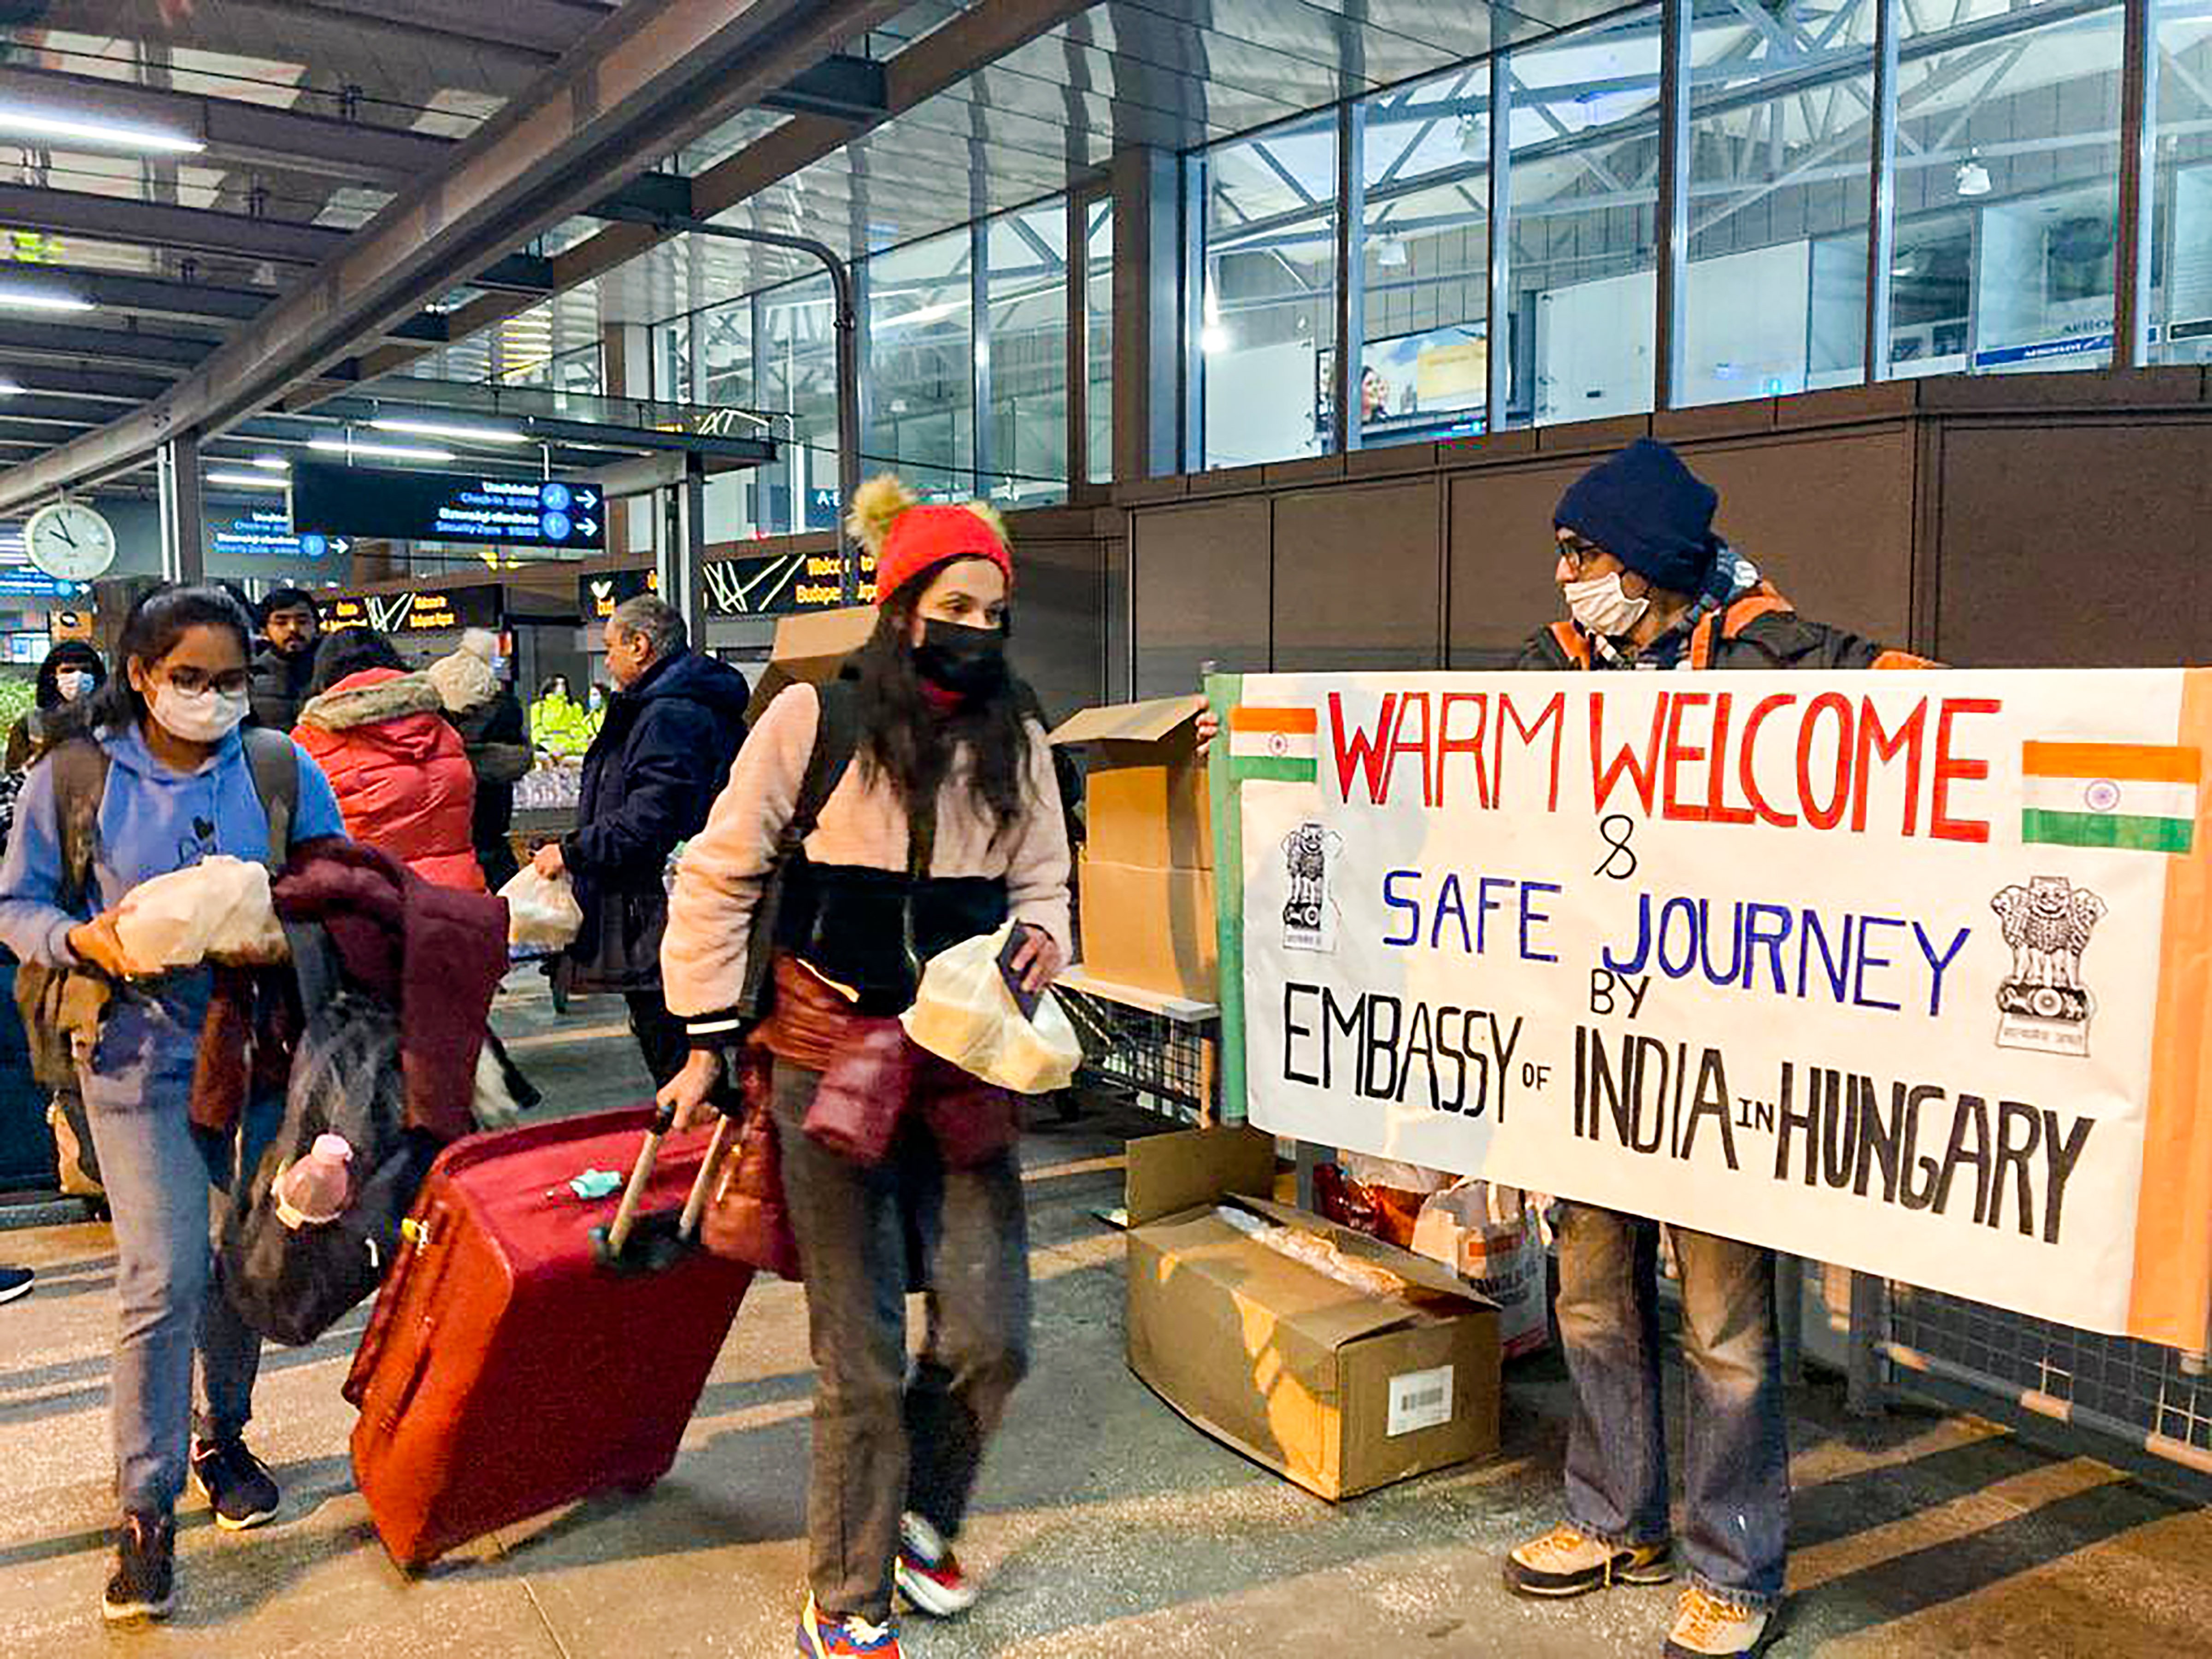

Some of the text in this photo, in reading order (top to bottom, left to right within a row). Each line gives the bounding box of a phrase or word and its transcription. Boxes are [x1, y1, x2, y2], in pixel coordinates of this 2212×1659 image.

[796, 584, 842, 605] Budape
[1328, 691, 2002, 843] WARM WELCOME
[1382, 870, 1971, 1017] SAFE JOURNEY
[1590, 968, 1650, 1019] BY
[1283, 982, 2096, 1245] EMBASSY OF INDIA IN HUNGARY
